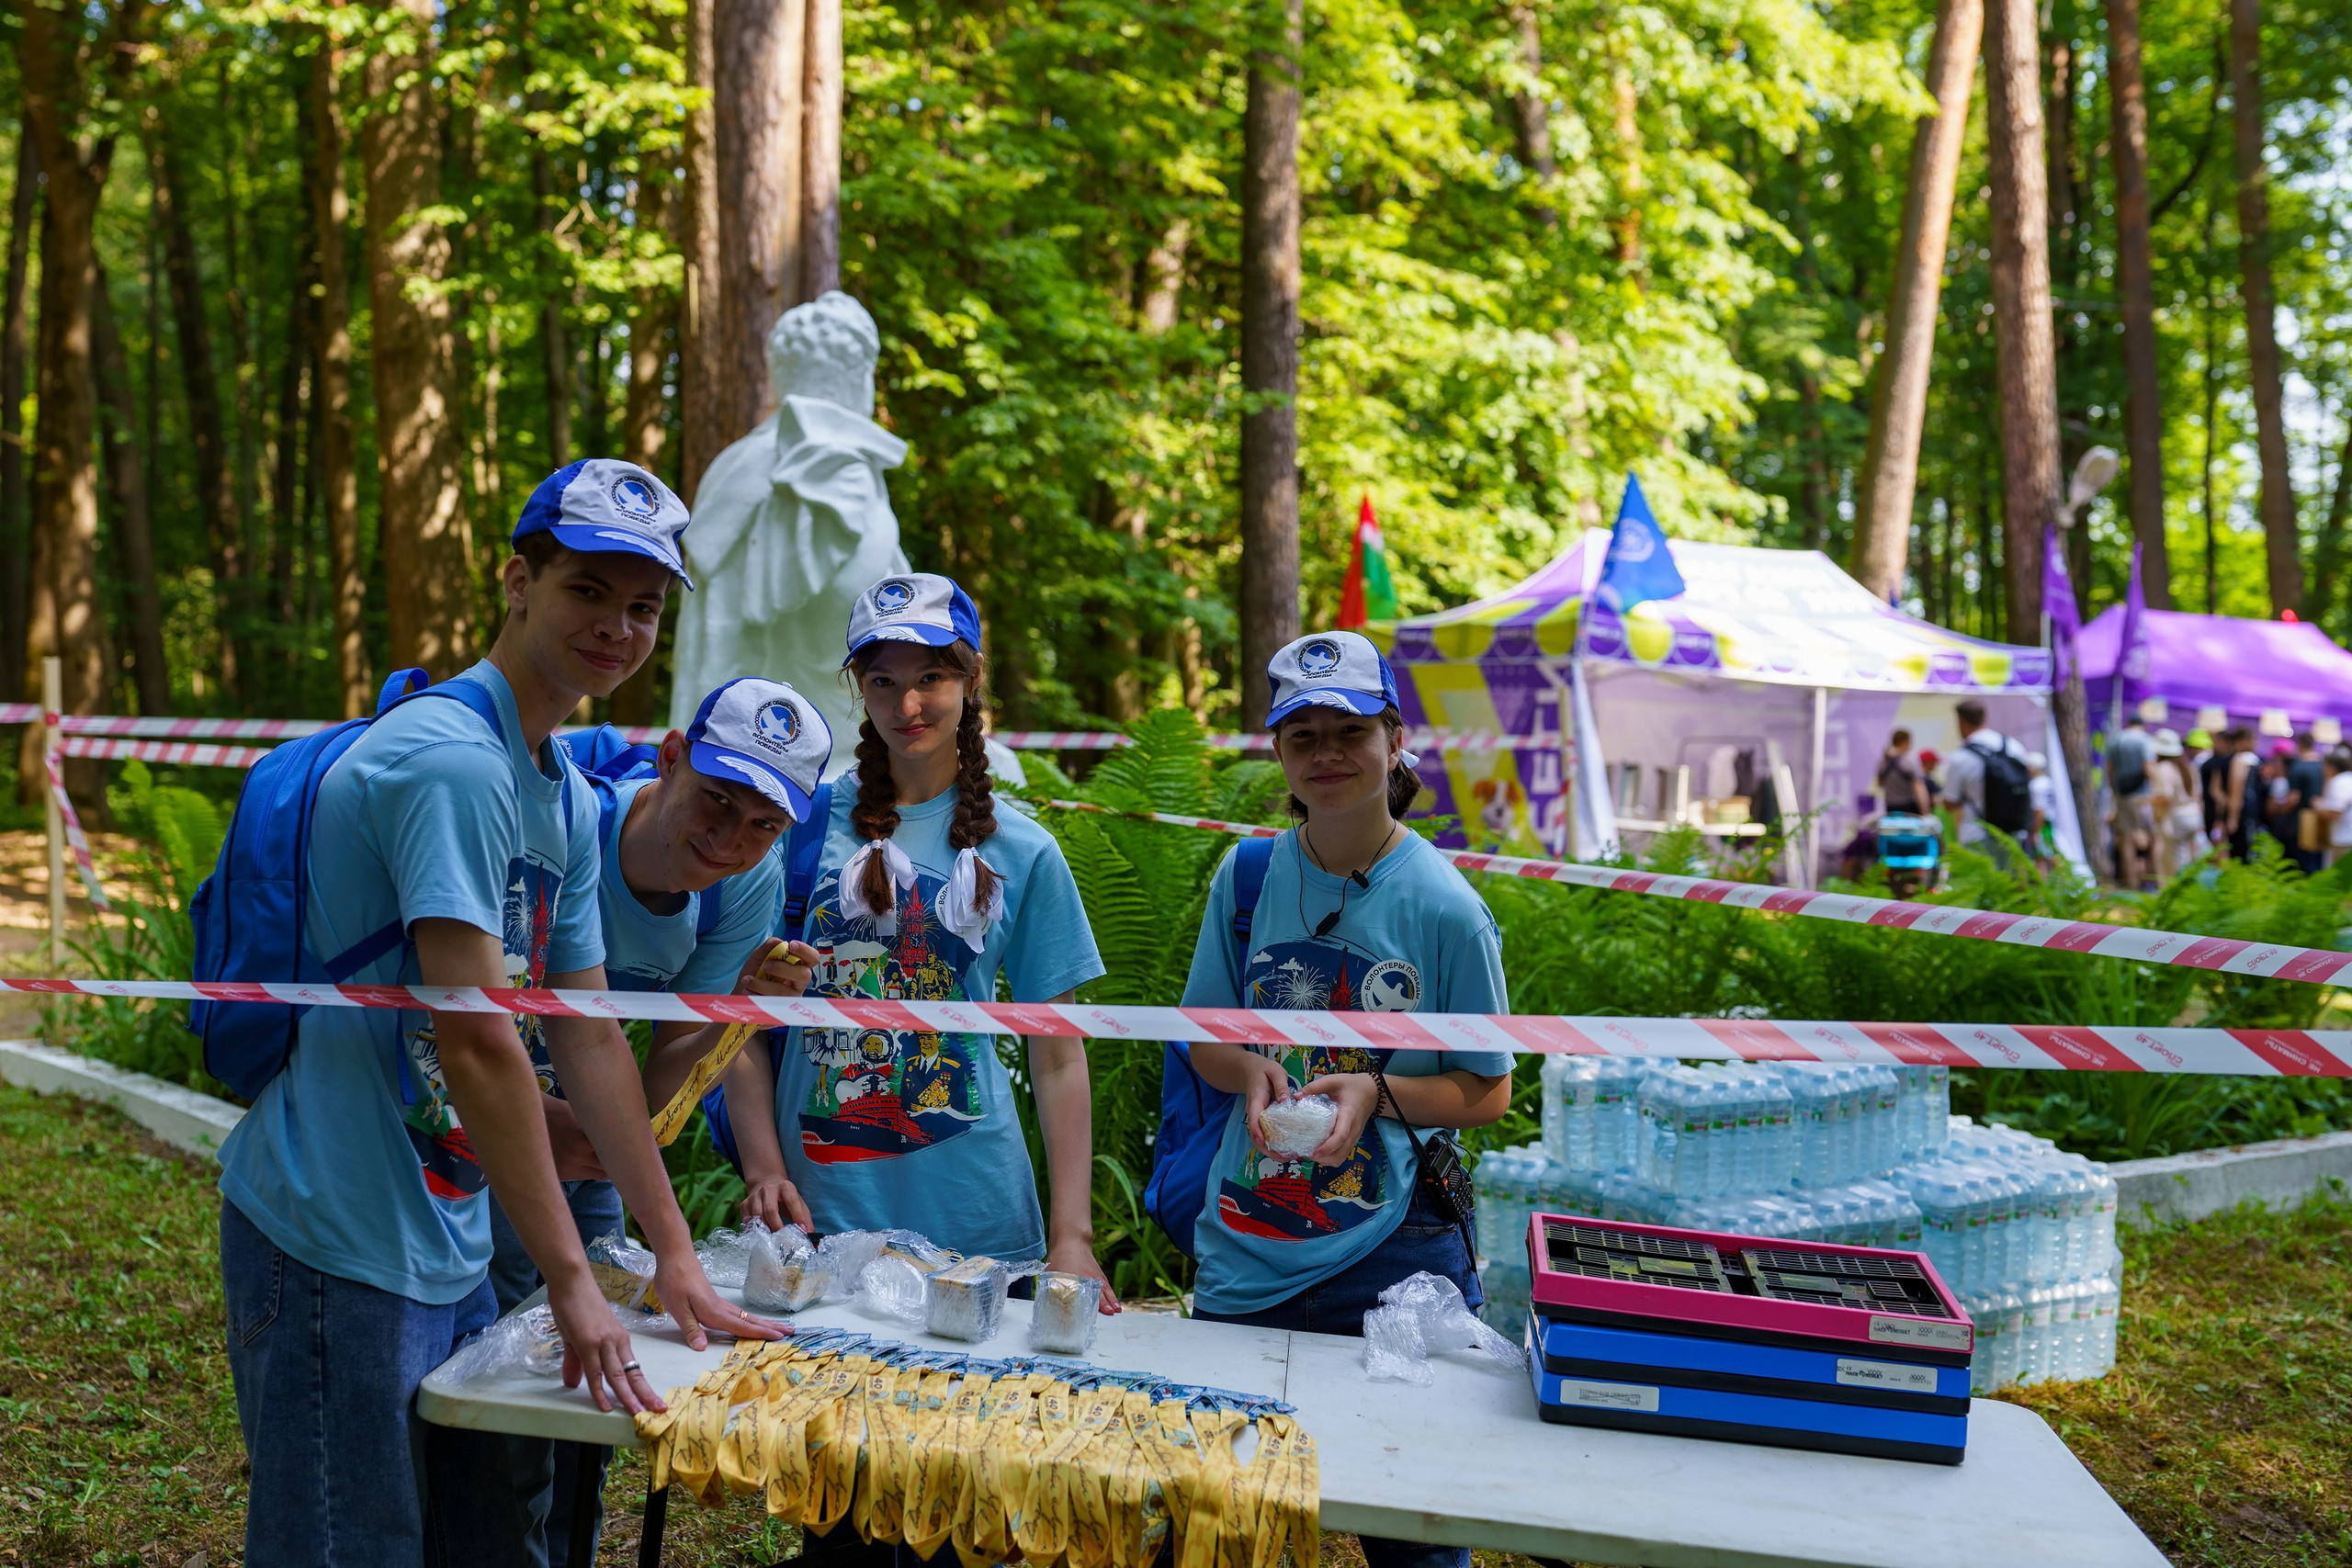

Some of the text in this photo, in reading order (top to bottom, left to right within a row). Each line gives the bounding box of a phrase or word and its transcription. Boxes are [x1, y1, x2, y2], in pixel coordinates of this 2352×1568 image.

[621, 513, 650, 525] ПОБЕДЫ
[755, 739, 782, 755] ПОБЕДЫ
[1364, 962, 1421, 999] ВОЛОНТЕРЫ ПОБЕДЫ
[873, 1377, 883, 1391] 40
